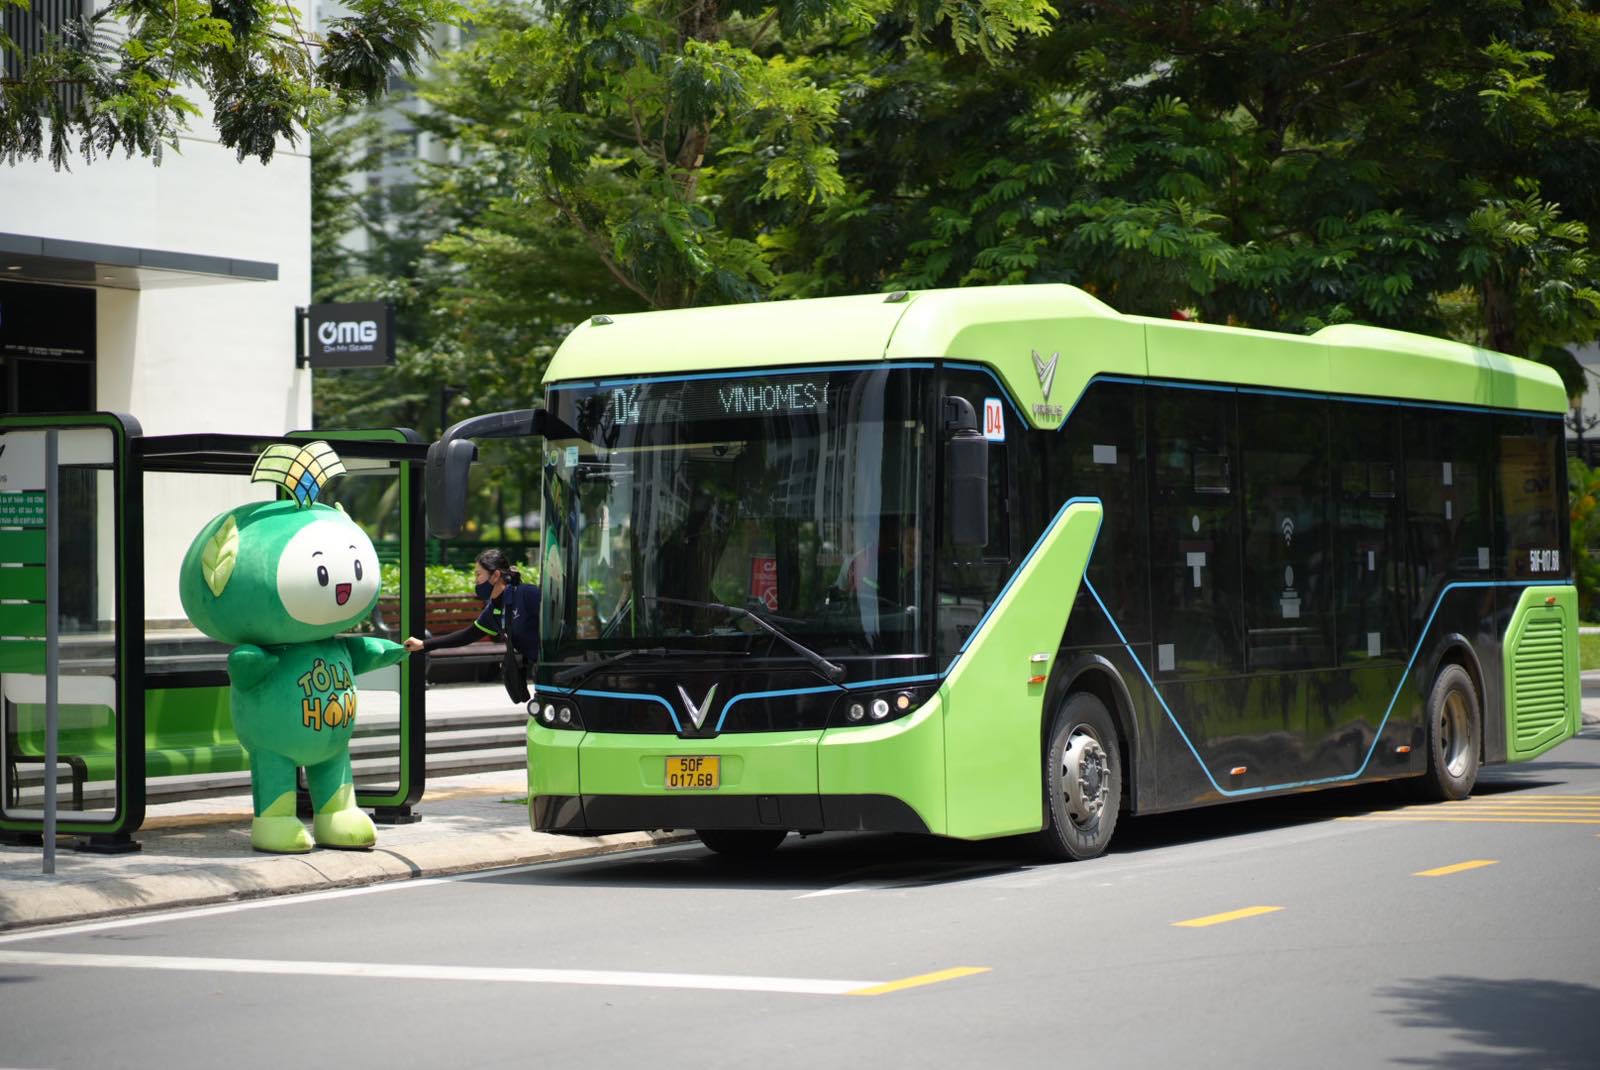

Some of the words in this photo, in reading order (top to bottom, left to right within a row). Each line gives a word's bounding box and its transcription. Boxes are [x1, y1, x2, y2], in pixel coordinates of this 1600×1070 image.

[318, 321, 377, 344] OMG
[614, 388, 640, 424] D4
[719, 383, 817, 412] VINHOMES
[986, 404, 1001, 434] D4
[302, 692, 356, 732] HÔM
[680, 758, 704, 772] 50F
[670, 773, 713, 787] 017.68
